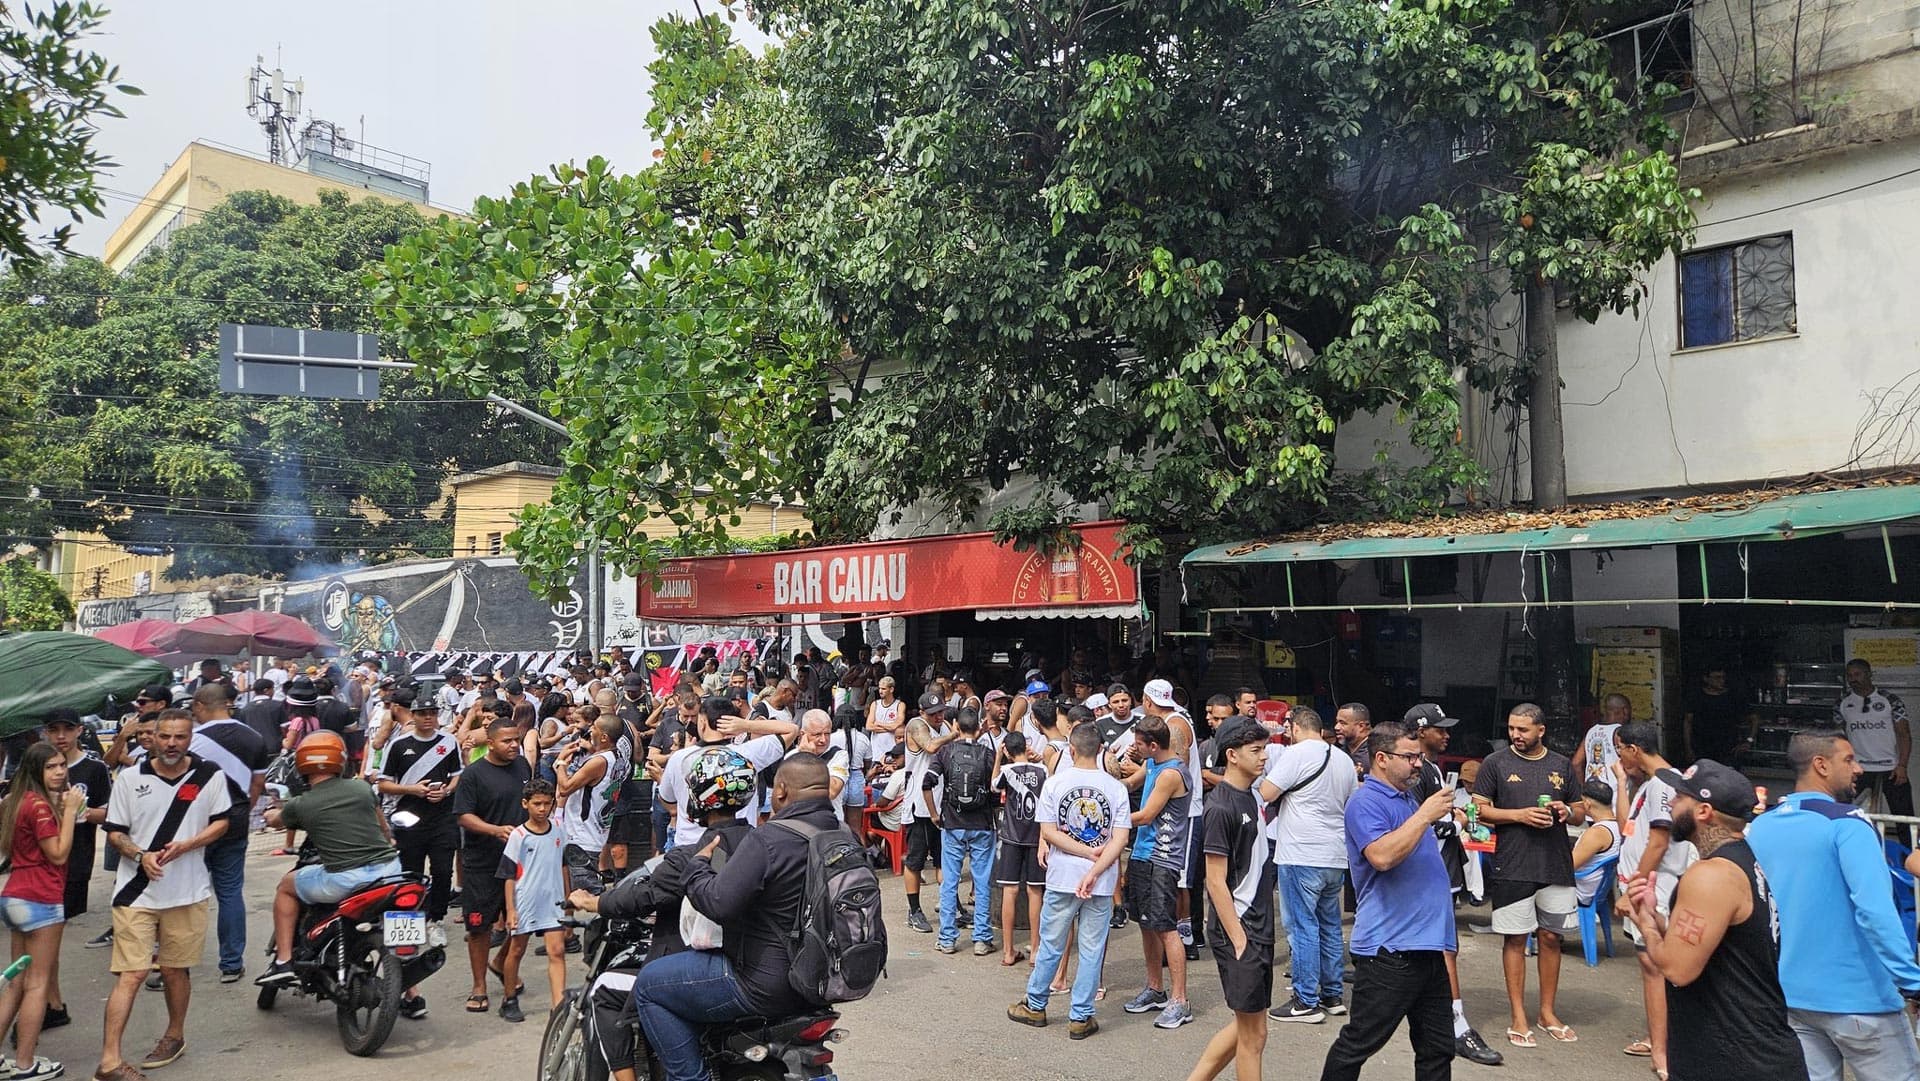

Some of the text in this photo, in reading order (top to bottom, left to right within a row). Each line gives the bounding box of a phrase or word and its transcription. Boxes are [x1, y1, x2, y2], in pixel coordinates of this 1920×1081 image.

[1052, 561, 1077, 573] BRAHMA
[774, 553, 906, 605] BAR CAIAU
[1016, 791, 1037, 820] 10
[394, 919, 416, 930] LVE
[391, 930, 421, 942] 9B22
